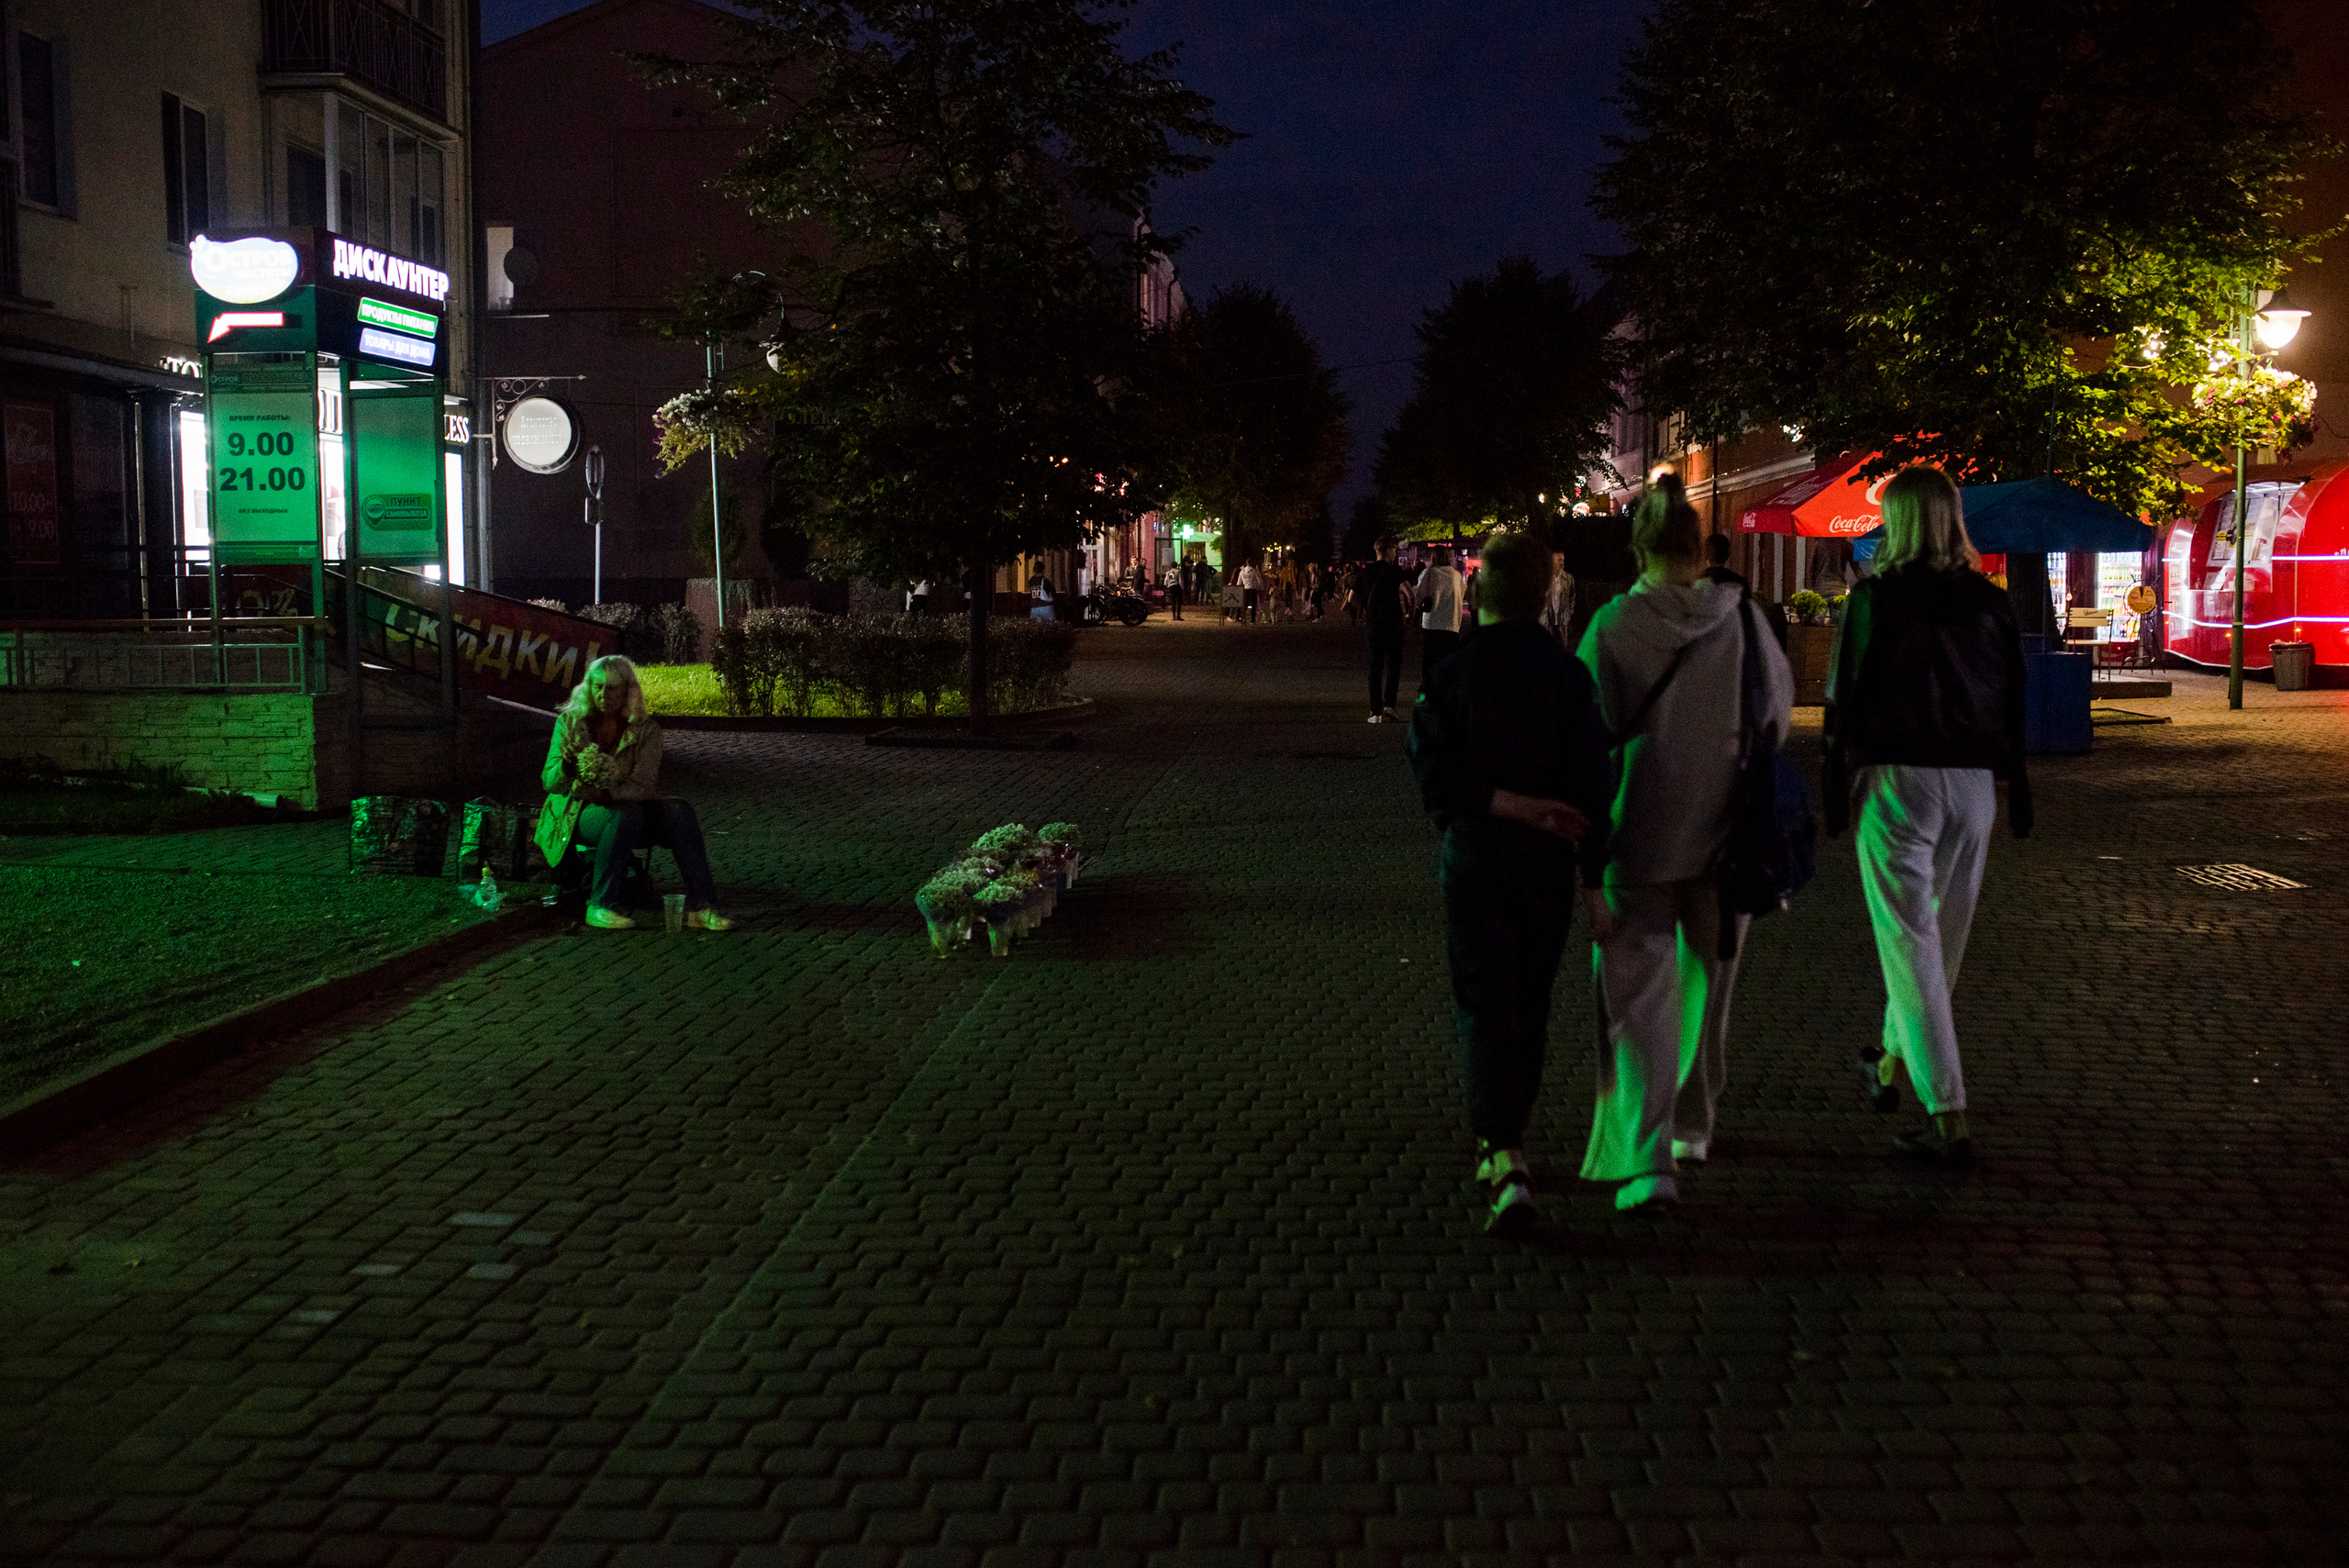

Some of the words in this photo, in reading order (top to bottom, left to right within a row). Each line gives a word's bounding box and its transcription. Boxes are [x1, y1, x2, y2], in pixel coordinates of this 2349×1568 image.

[332, 239, 450, 302] ДИСКАУНТЕР
[362, 304, 402, 325] ПРОДУКТЫ
[364, 333, 395, 351] ТОВАРЫ
[228, 431, 295, 457] 9.00
[218, 466, 306, 492] 21.00
[390, 496, 422, 507] ПУНКТ
[1829, 514, 1881, 533] Coca-Cola
